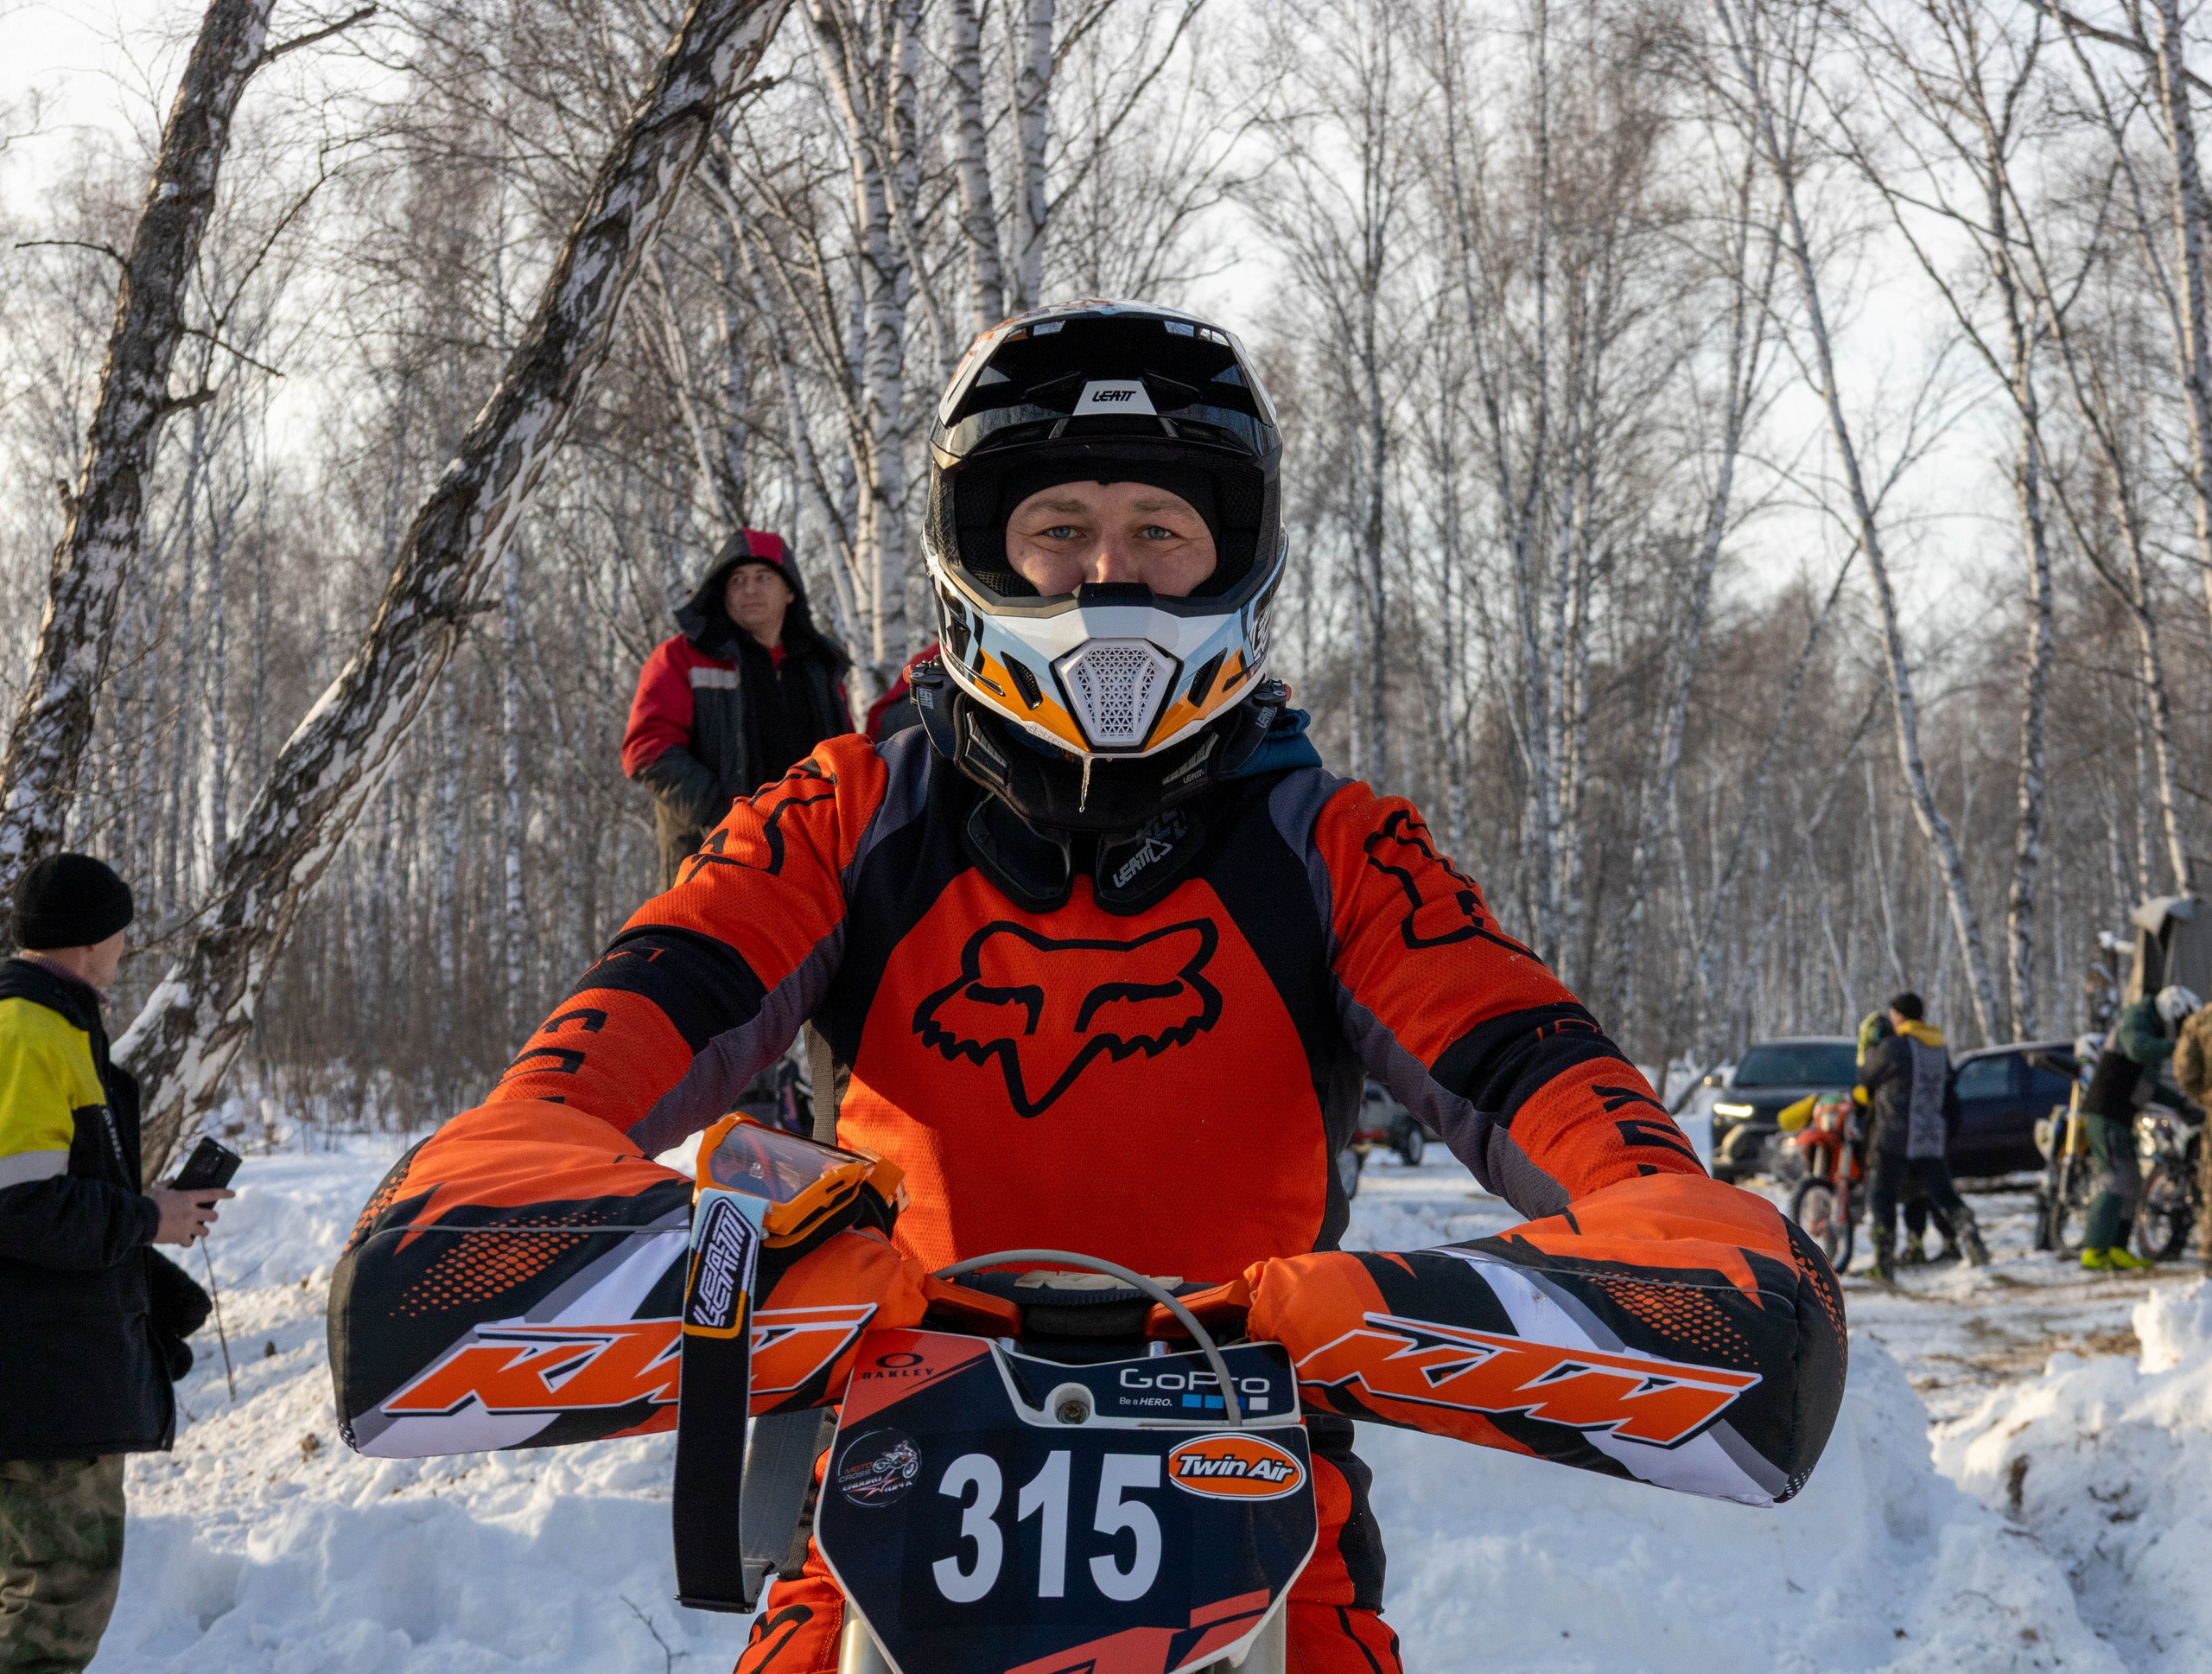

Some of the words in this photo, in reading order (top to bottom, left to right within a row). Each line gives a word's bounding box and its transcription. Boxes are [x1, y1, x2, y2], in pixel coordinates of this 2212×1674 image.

[1092, 390, 1137, 403] LEATT
[918, 688, 935, 710] LEATT
[1255, 706, 1275, 729] LEATT
[1182, 768, 1204, 784] LEATT
[1112, 840, 1154, 888] LEATT
[692, 1205, 747, 1327] LEATT
[861, 1368, 934, 1380] OAKLEY
[1294, 1310, 1764, 1450] KTM
[1119, 1397, 1131, 1405] Be
[1139, 1397, 1173, 1407] HERO.
[838, 1468, 872, 1483] CROSS
[1175, 1452, 1247, 1480] Twin
[1249, 1459, 1294, 1482] Air
[931, 1449, 1162, 1604] 315
